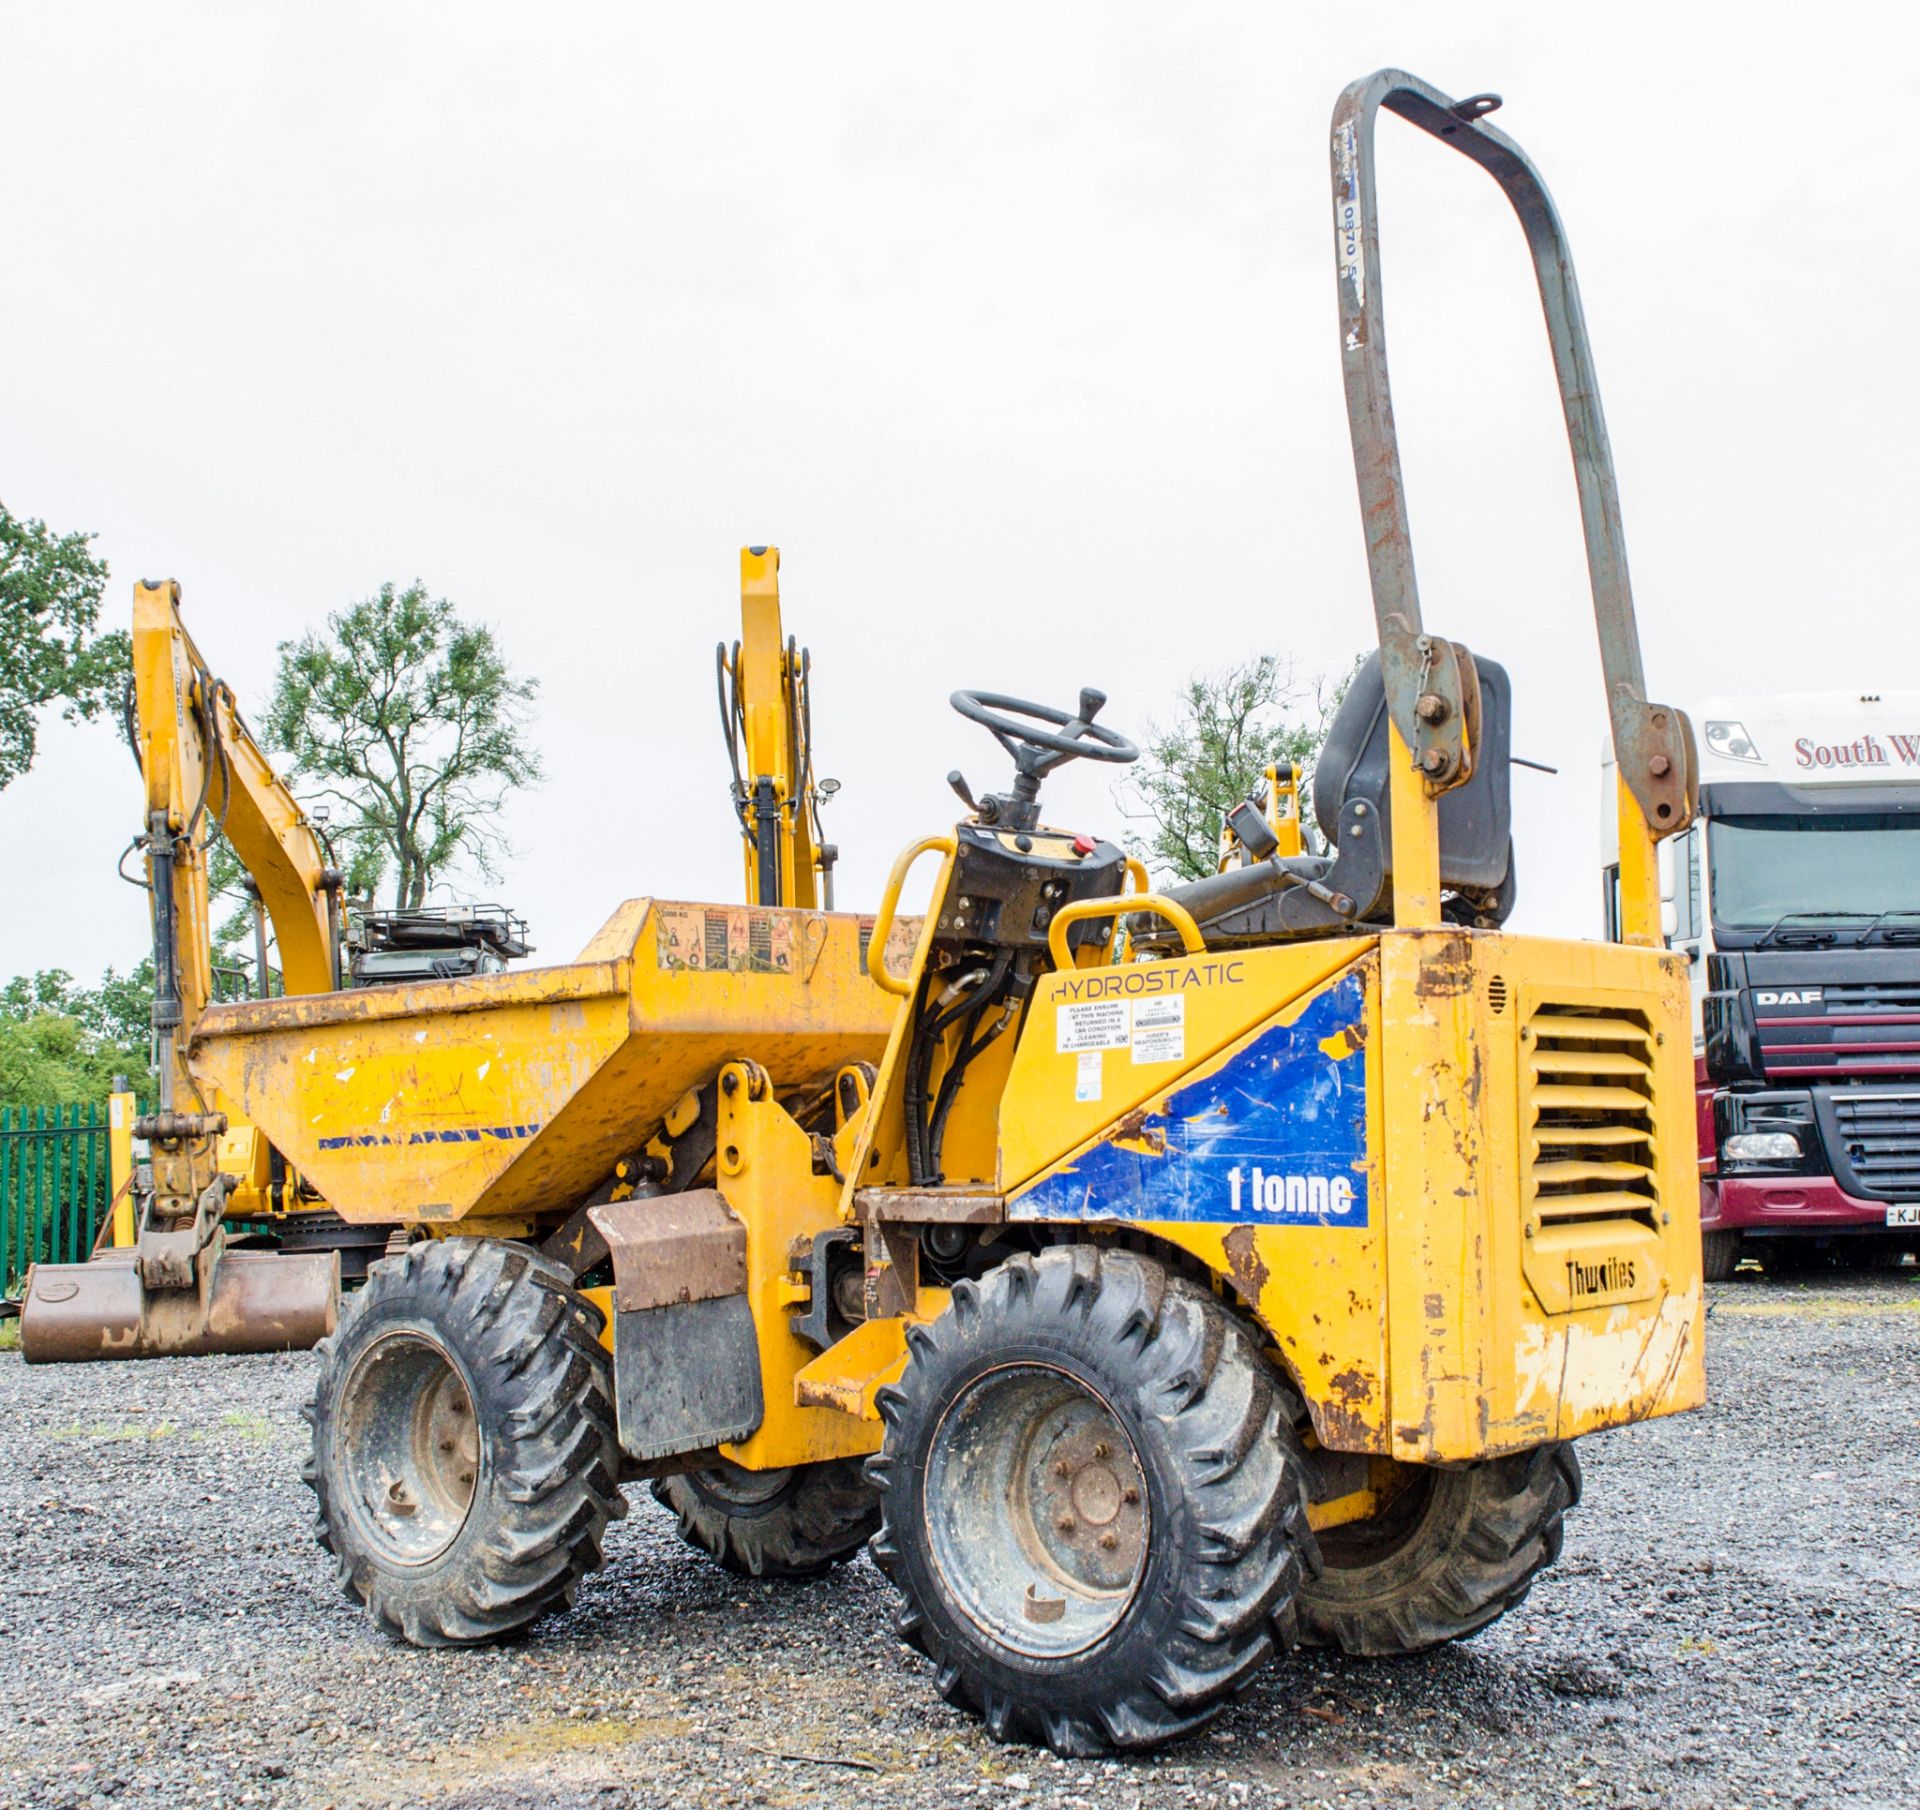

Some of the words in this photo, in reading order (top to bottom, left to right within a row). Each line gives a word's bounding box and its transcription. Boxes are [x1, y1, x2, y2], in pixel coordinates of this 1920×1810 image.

[1344, 206, 1356, 256] 0870
[1793, 734, 1888, 768] South
[1051, 961, 1244, 1002] HYDROSTATIC
[1756, 991, 1822, 1006] DAF
[1094, 1003, 1119, 1011] ENSURE
[1096, 1010, 1124, 1018] MACHINE
[1075, 1018, 1107, 1027] RETURNED
[1088, 1025, 1121, 1033] CONDITION
[1070, 1040, 1111, 1048] CHARGEABLE
[1227, 1166, 1242, 1211] 1
[1252, 1166, 1353, 1215] tonne
[1897, 1208, 1920, 1223] KJ
